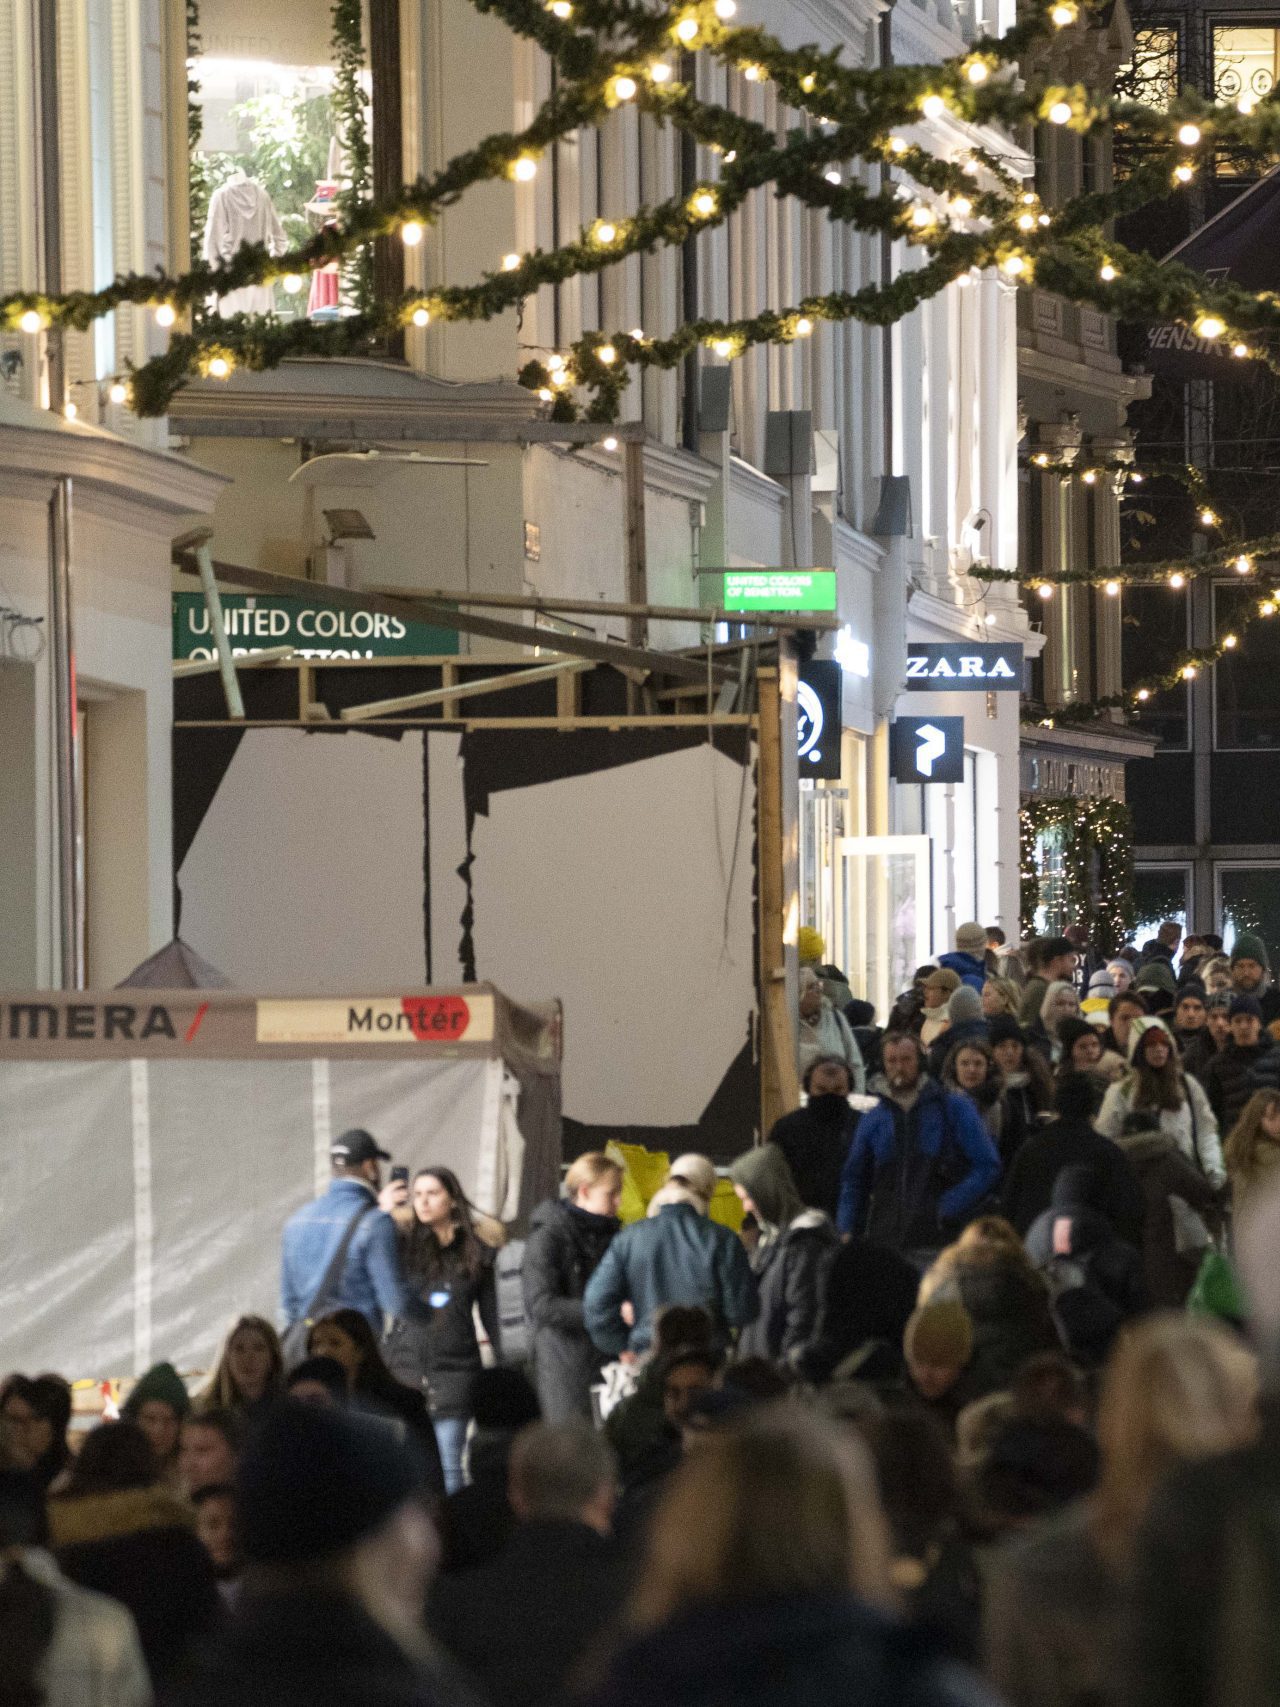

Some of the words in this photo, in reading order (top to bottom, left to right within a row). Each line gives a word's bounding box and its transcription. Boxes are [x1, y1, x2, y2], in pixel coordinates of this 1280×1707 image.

[296, 610, 406, 639] COLORS
[906, 657, 1015, 678] ZARA
[348, 1003, 463, 1032] Montér
